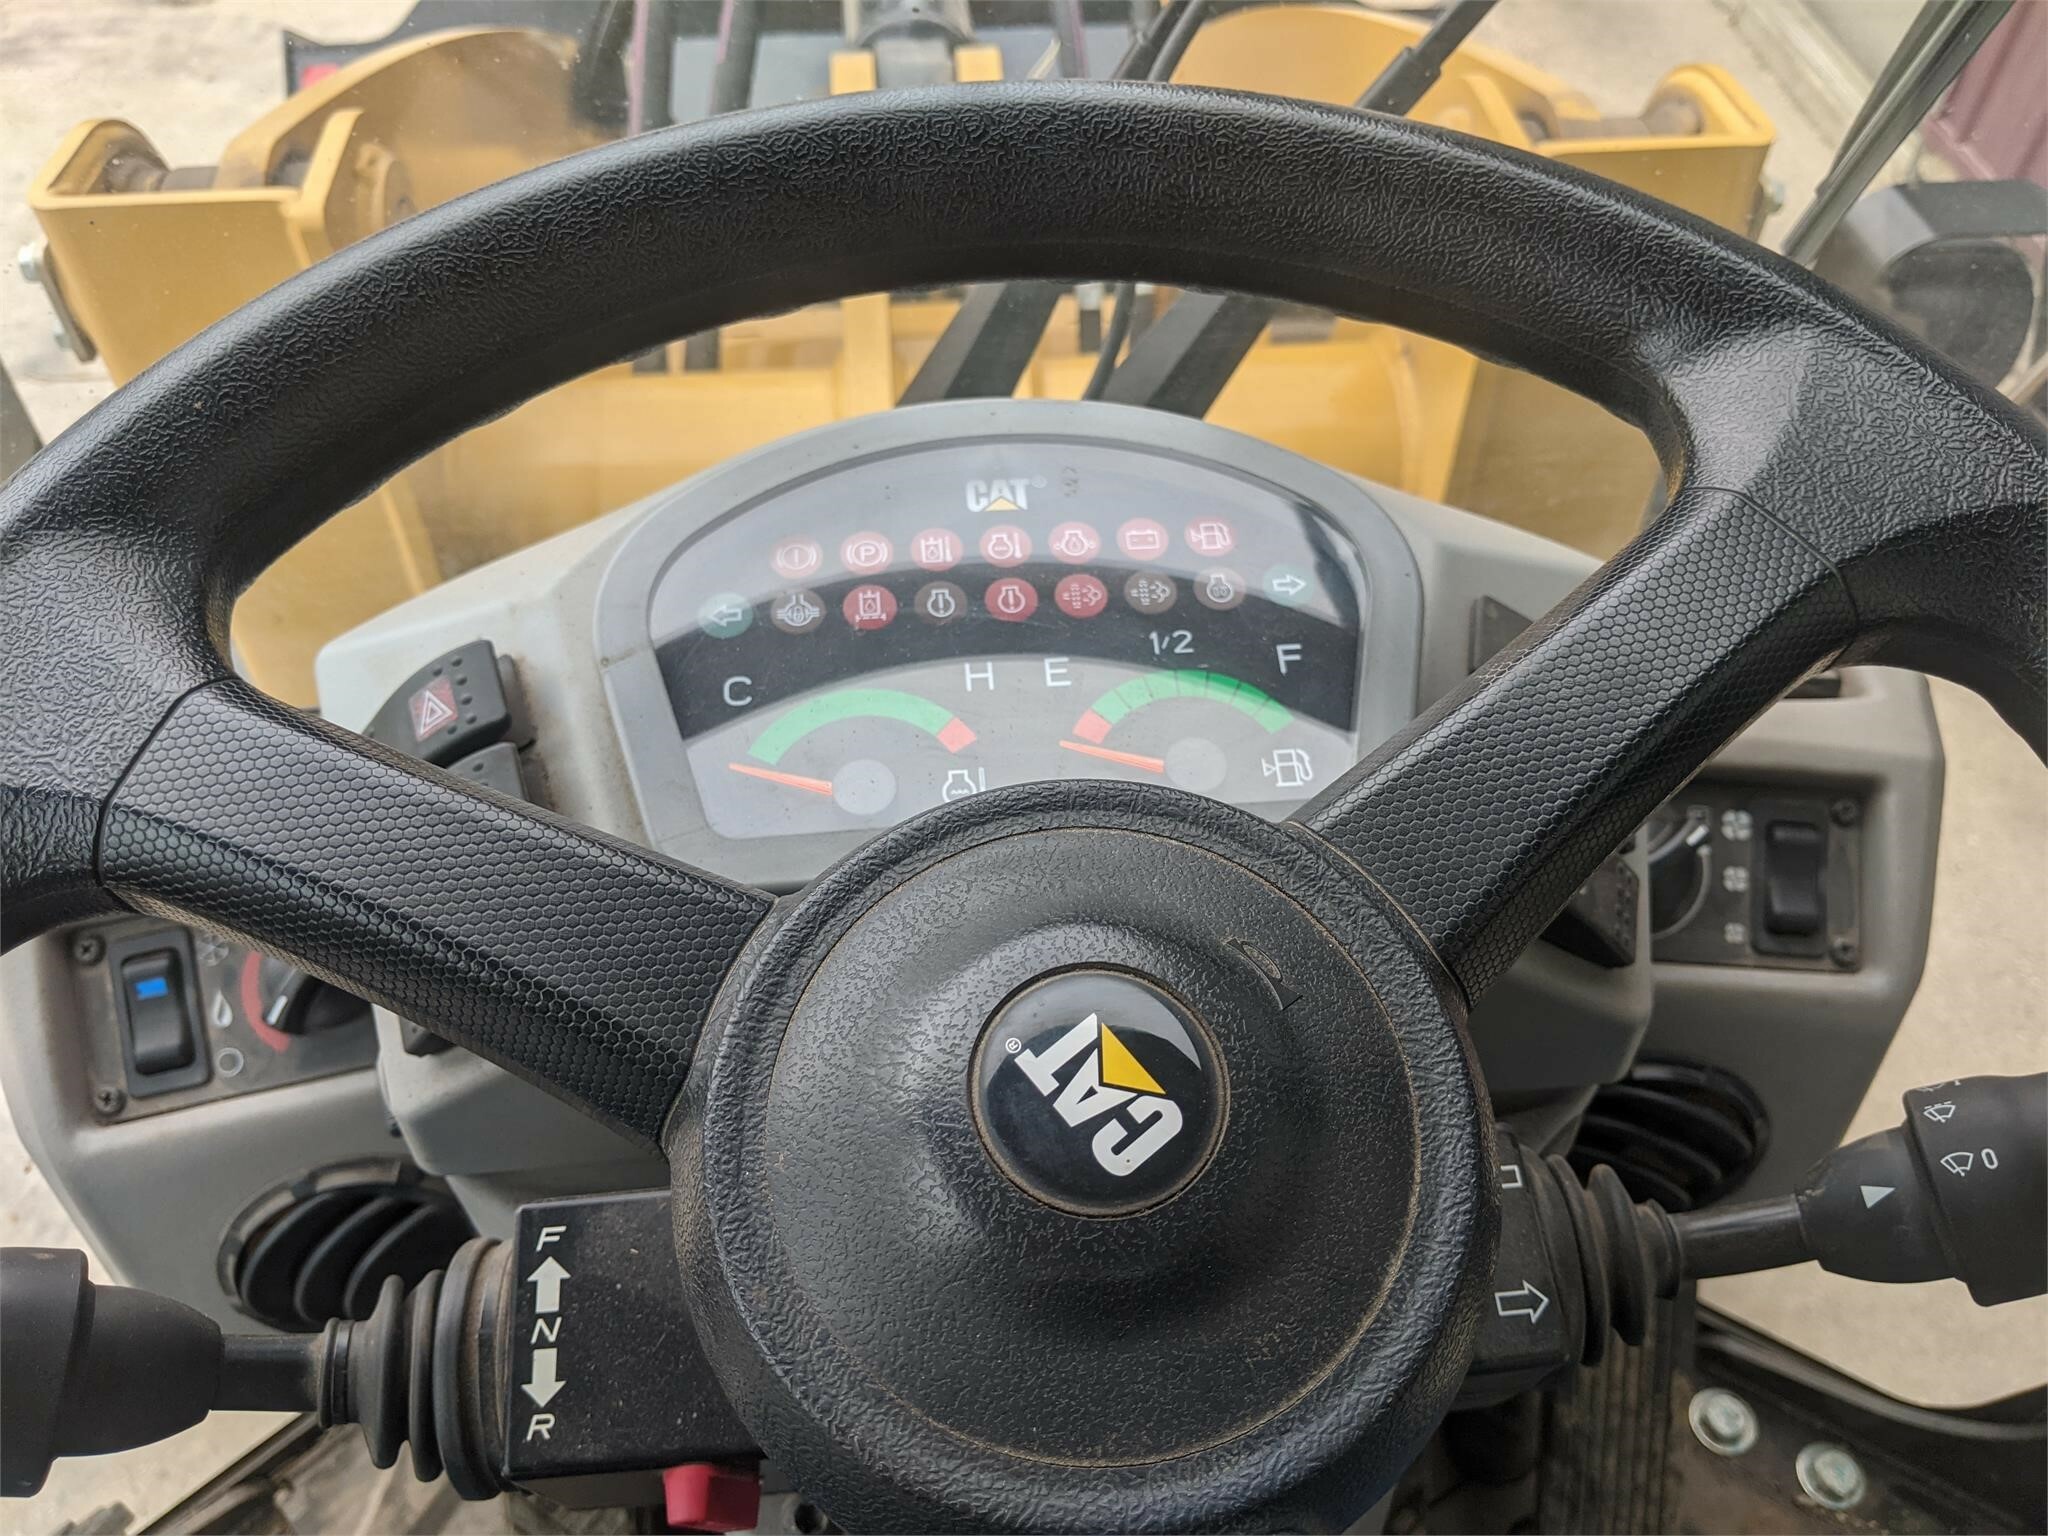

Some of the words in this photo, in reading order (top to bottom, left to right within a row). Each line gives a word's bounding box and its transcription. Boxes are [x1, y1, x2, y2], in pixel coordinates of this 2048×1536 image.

[966, 479, 1028, 512] CAT
[1149, 630, 1195, 654] 1/2
[1044, 657, 1072, 687] E
[1276, 643, 1302, 676] F
[723, 676, 753, 706] C
[964, 661, 995, 691] H
[1014, 1012, 1183, 1177] CAT
[536, 1225, 567, 1252] F
[530, 1316, 562, 1345] N
[526, 1413, 556, 1442] R
